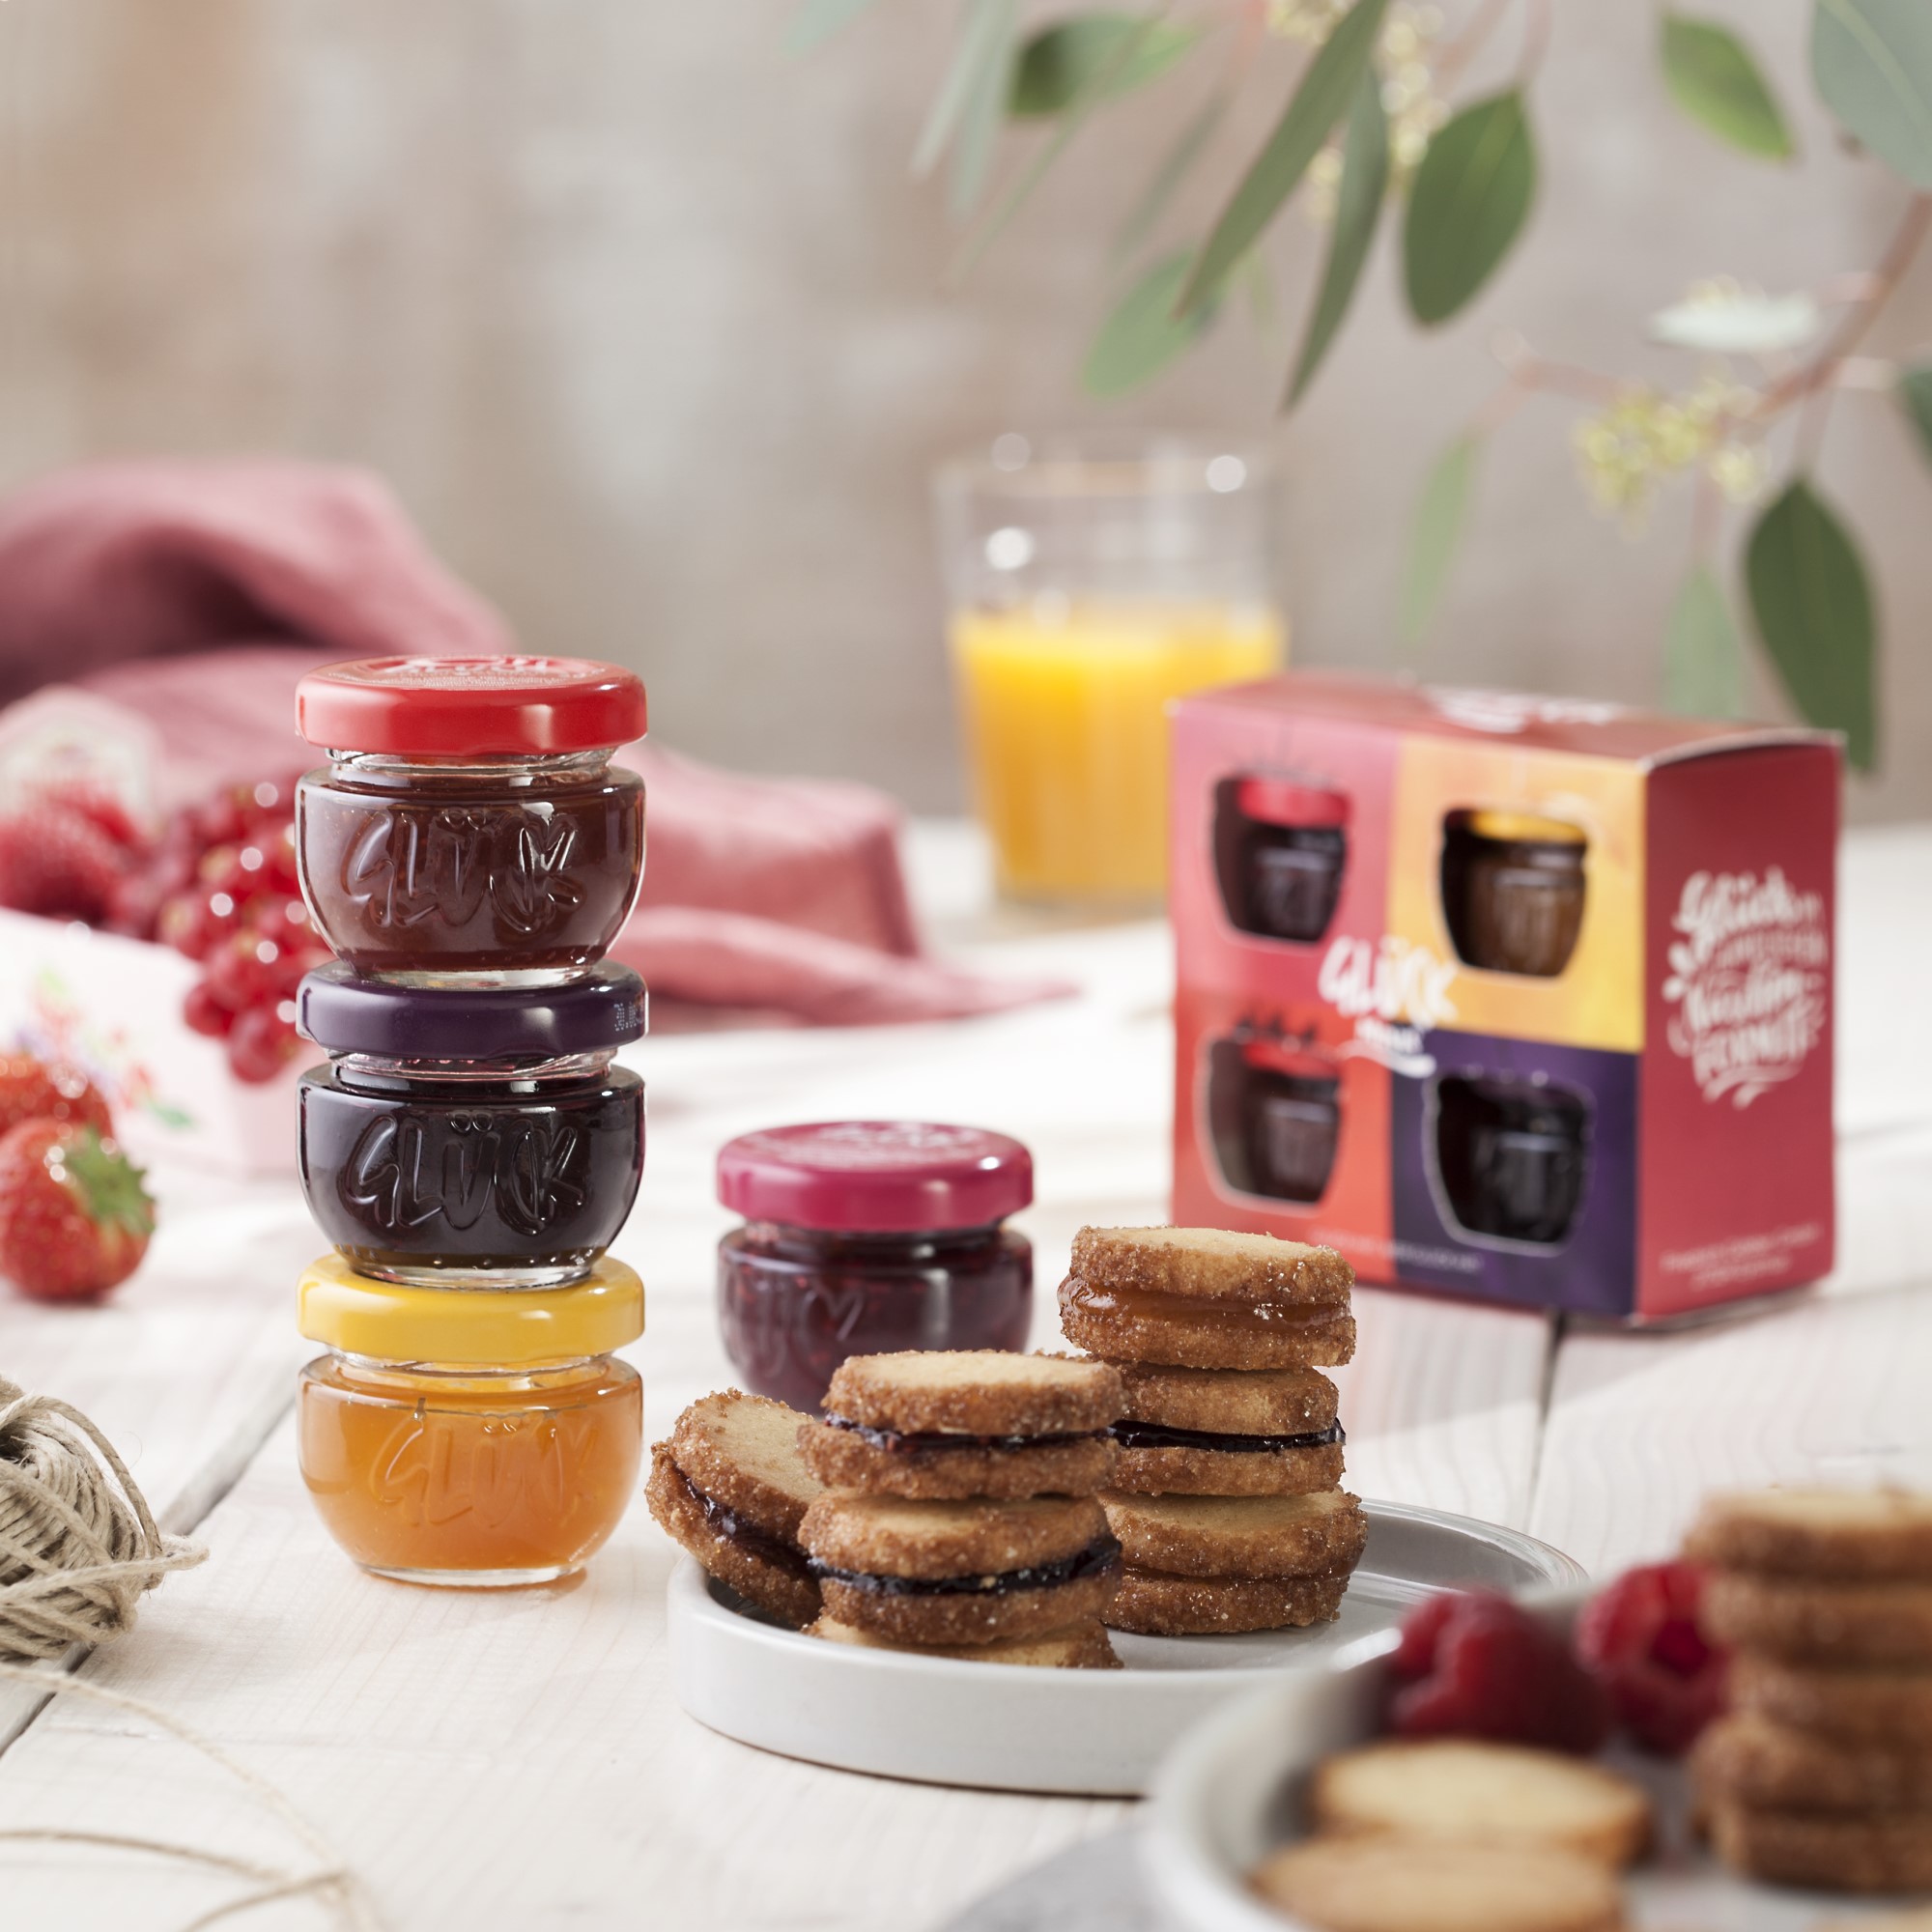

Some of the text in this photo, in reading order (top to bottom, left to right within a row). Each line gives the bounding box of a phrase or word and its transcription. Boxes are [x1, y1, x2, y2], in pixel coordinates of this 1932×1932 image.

[341, 810, 586, 934] GLÜCK
[1318, 935, 1459, 1033] GLÜCK
[344, 1115, 585, 1236] GLÜCK
